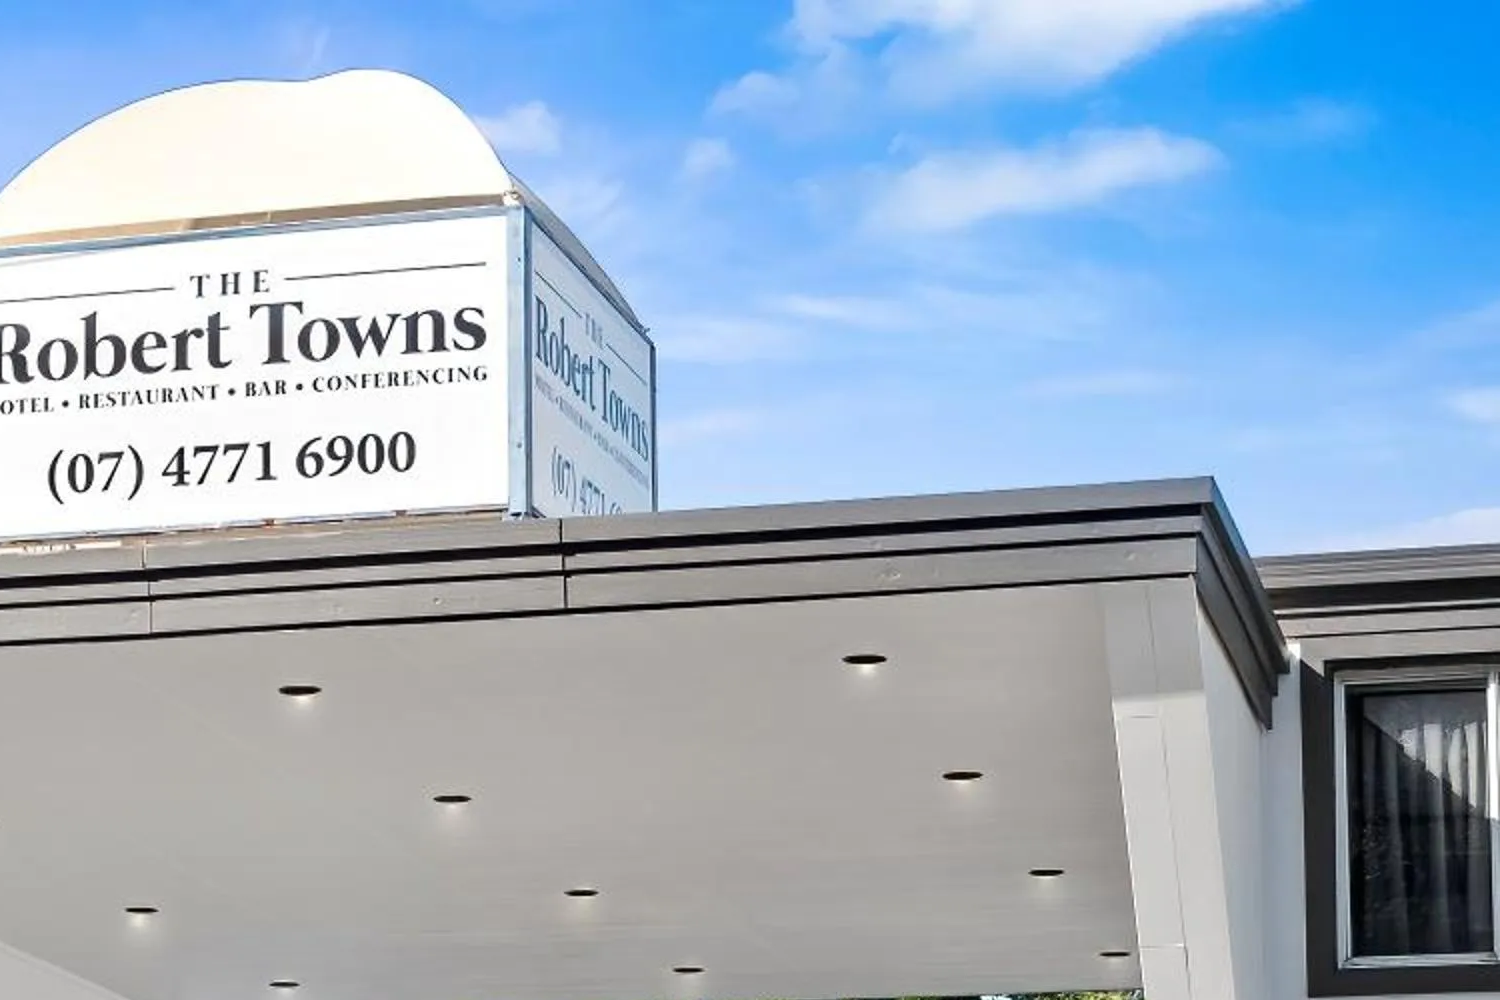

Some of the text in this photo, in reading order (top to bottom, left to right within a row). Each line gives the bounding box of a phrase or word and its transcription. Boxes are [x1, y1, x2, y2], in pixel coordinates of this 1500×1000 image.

[190, 270, 271, 299] THE
[249, 301, 487, 365] Towns
[78, 384, 221, 410] RESTAURANT
[245, 380, 288, 398] BAR
[312, 365, 489, 393] CONFERENCING
[535, 295, 596, 411] Robert
[598, 357, 649, 462] Towns
[47, 431, 417, 505] (07) 4771 6900
